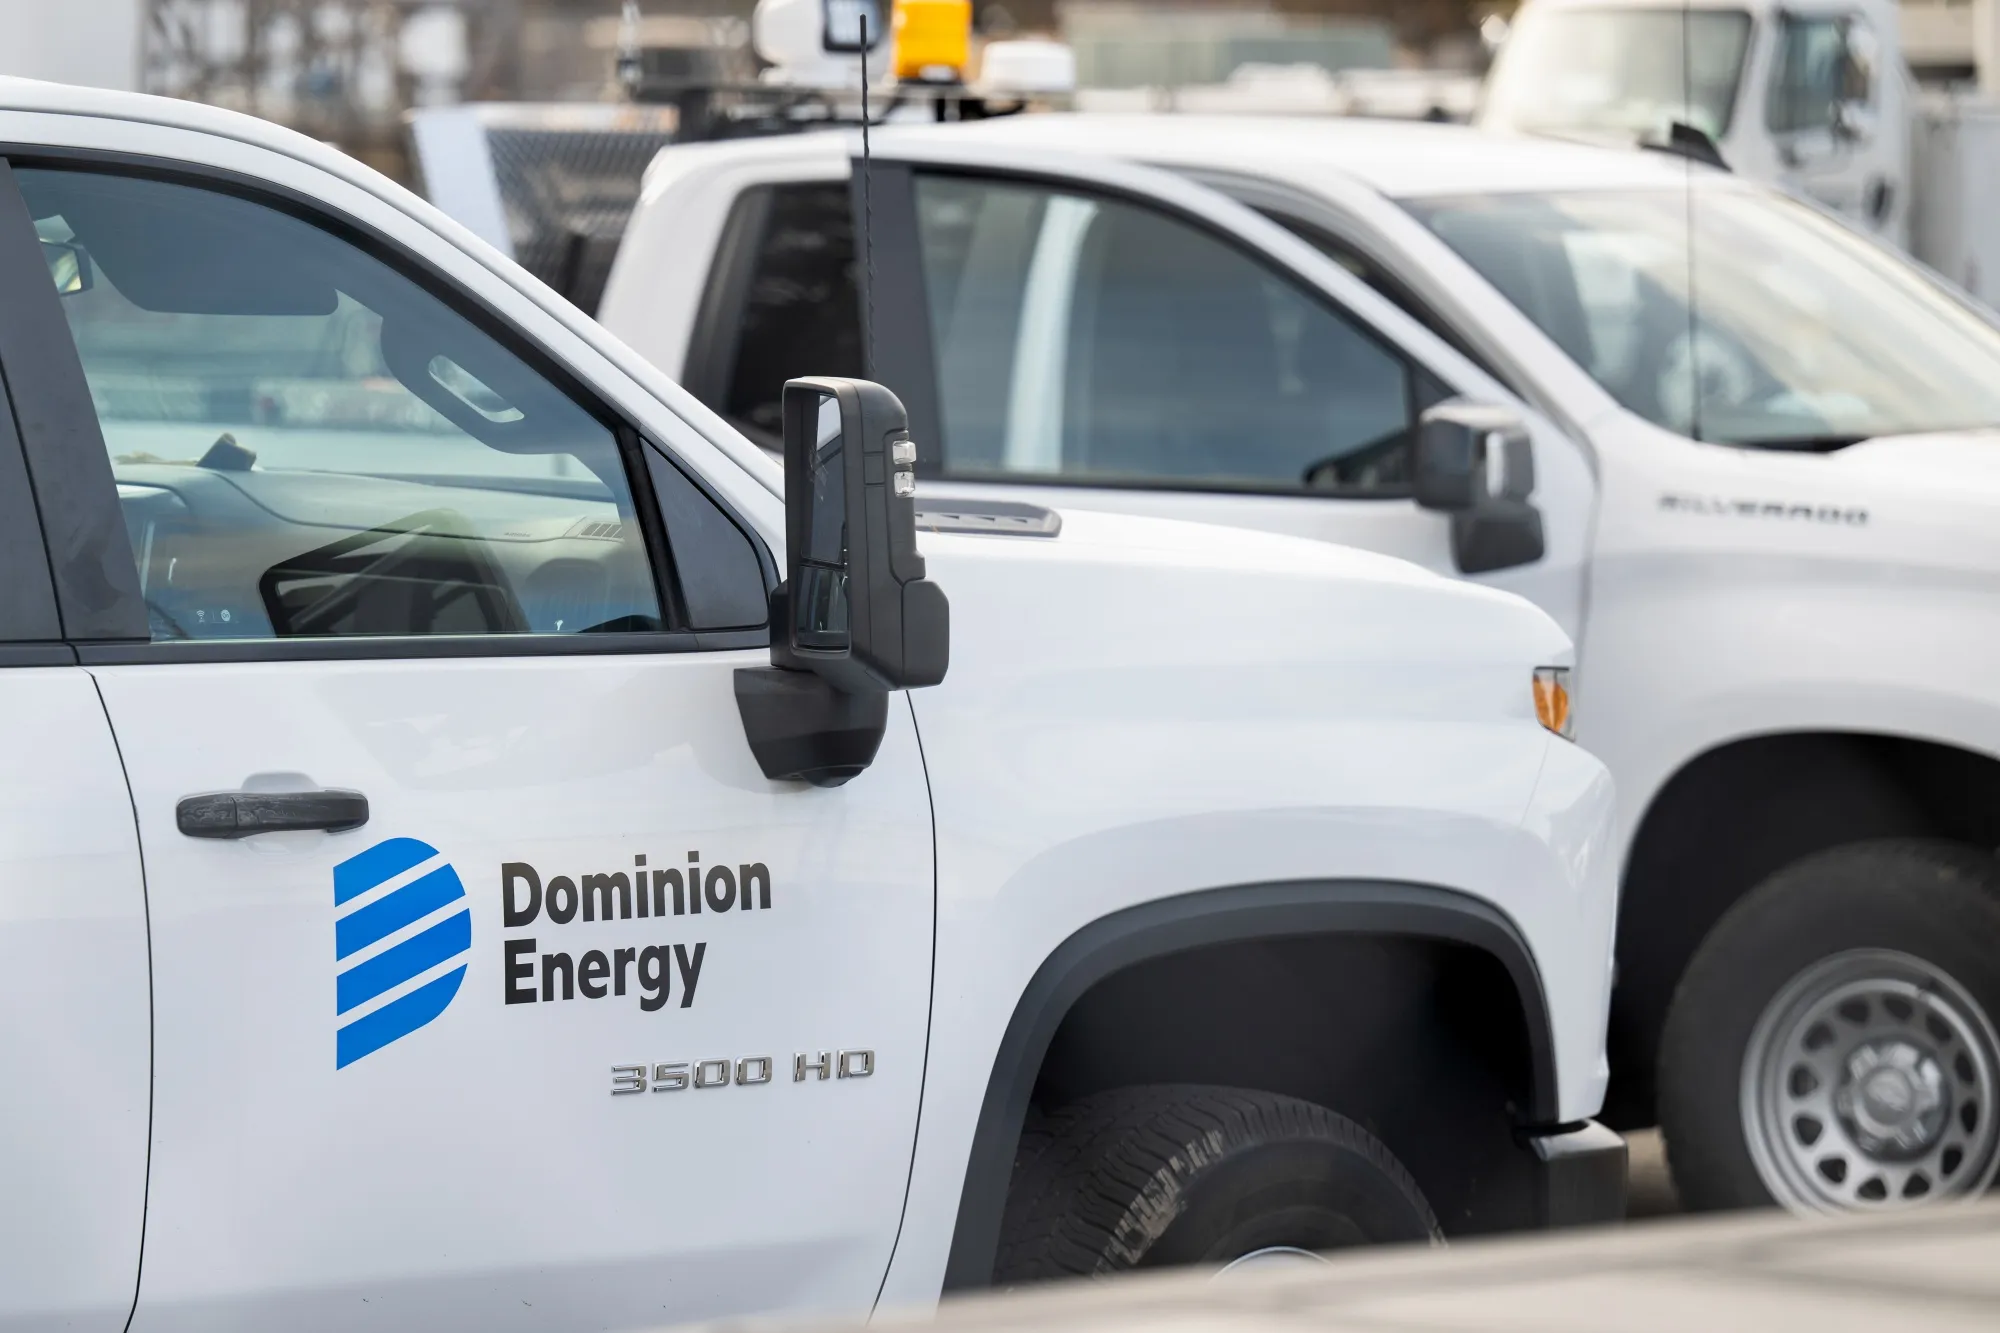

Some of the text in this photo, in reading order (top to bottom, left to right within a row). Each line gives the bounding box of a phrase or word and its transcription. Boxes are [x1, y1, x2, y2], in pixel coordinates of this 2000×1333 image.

[501, 850, 772, 928] Dominion
[503, 937, 708, 1013] Energy
[610, 1049, 875, 1097] 3500 HD
